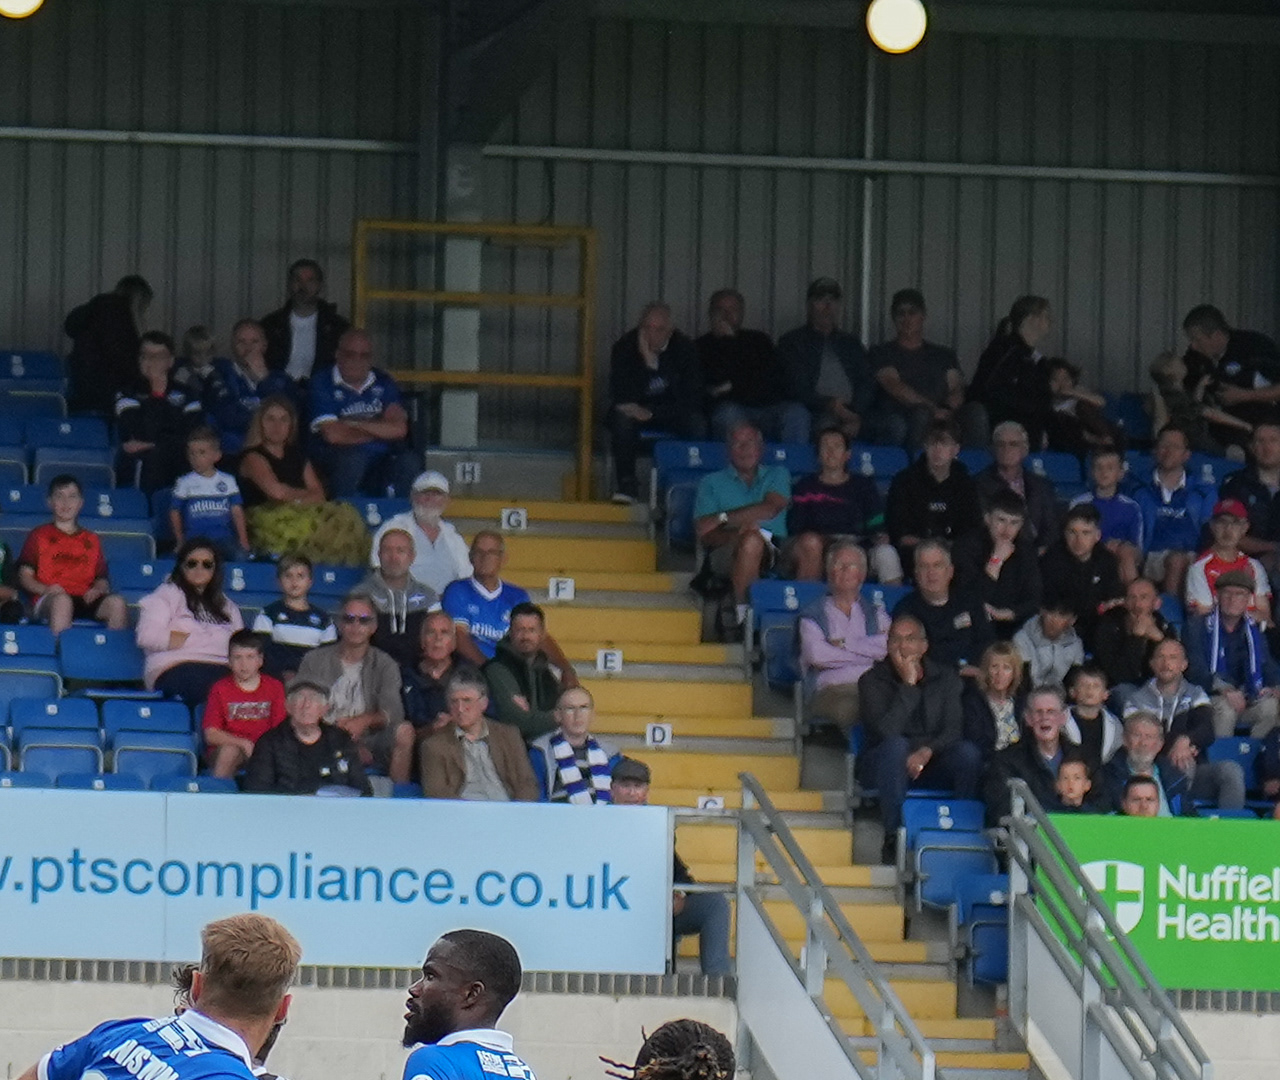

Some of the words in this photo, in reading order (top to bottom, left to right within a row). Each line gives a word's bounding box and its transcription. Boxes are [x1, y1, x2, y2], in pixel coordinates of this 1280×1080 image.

[507, 511, 522, 528] G
[555, 580, 569, 597] F
[603, 653, 617, 670] E
[652, 726, 666, 744] D
[1157, 903, 1280, 942] Health
